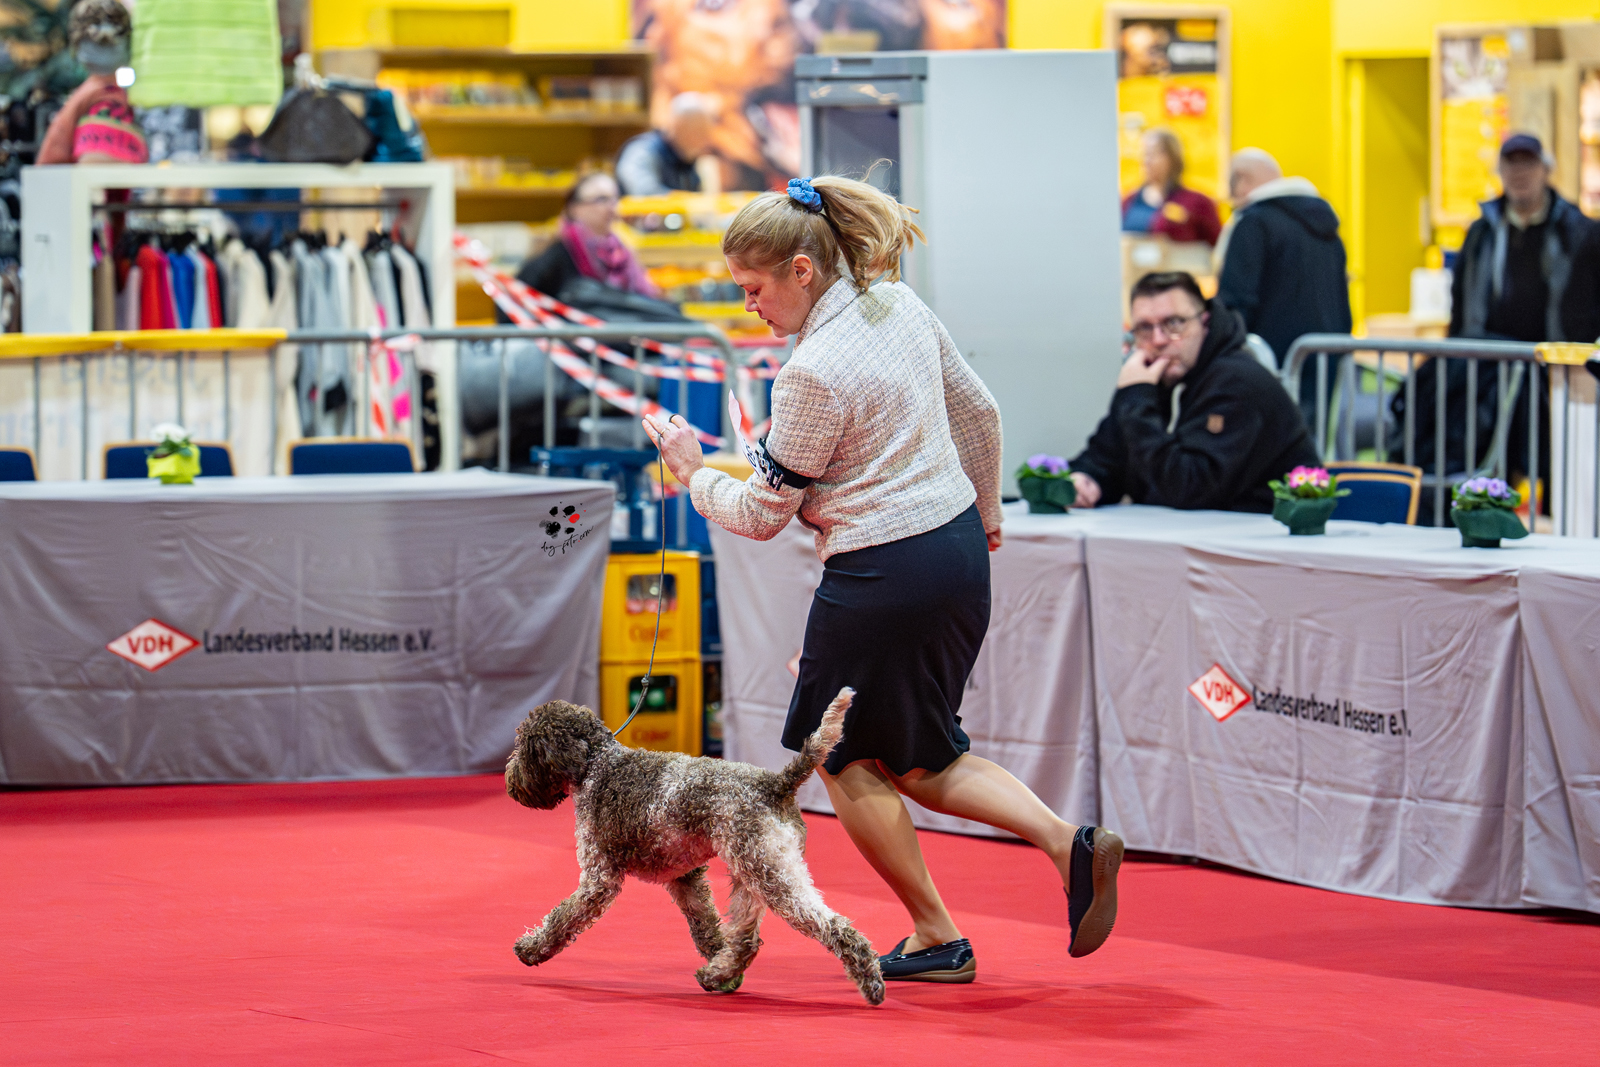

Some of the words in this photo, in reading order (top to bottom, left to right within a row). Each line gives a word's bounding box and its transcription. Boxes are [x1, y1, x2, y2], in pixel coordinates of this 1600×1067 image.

[127, 635, 174, 655] VDH
[203, 627, 333, 654] Landesverband
[339, 628, 399, 652] Hessen
[404, 629, 435, 652] e.V.
[1203, 681, 1235, 704] VDH
[1253, 685, 1340, 727] Landesverband
[1344, 702, 1385, 734] Hessen
